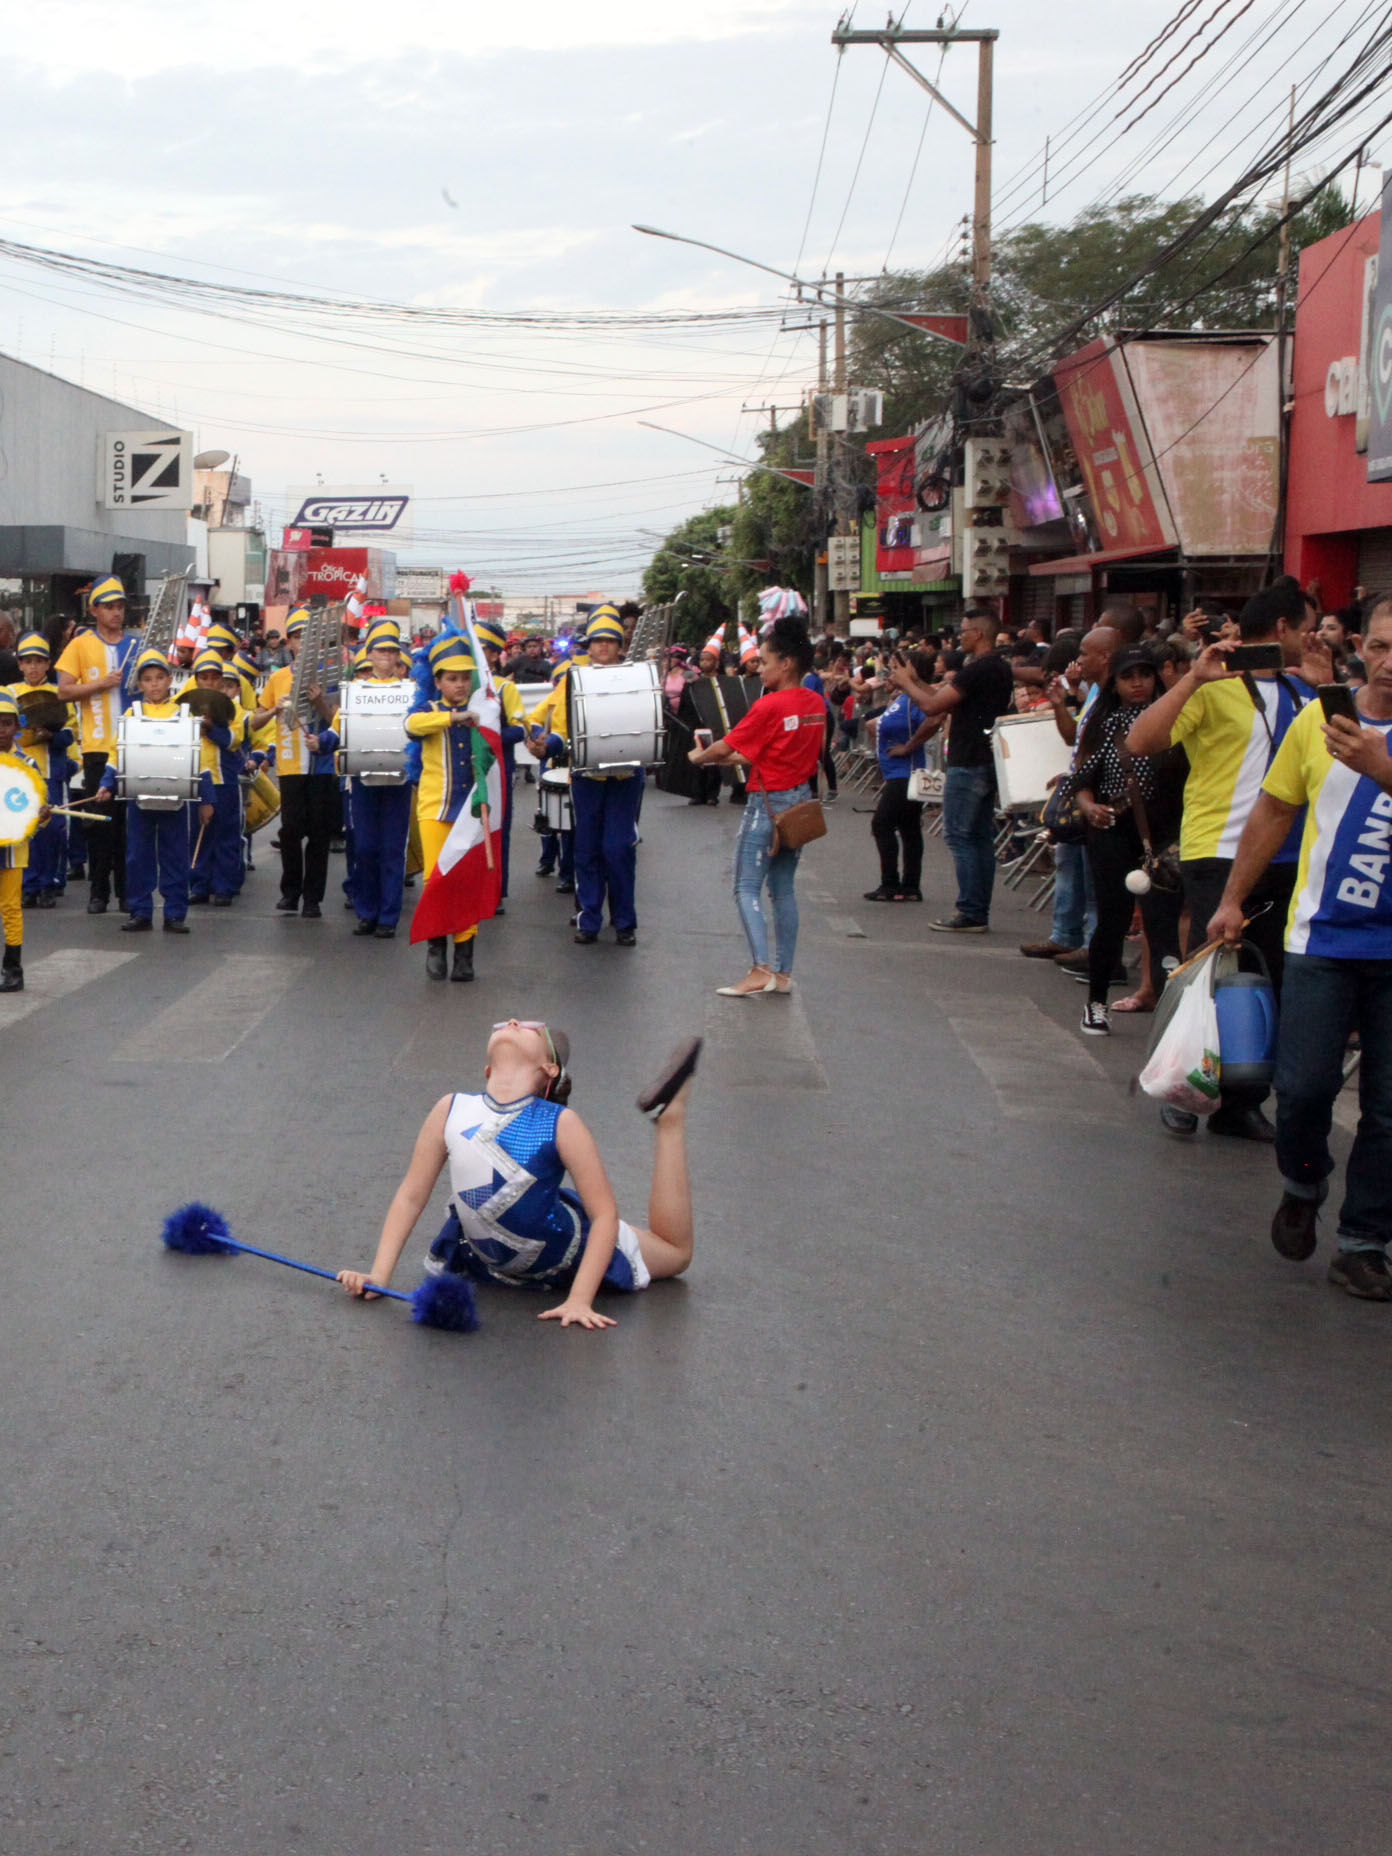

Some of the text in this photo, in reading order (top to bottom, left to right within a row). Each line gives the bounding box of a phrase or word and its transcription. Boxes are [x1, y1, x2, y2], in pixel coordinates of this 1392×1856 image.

[113, 440, 125, 503] STUDIO
[355, 695, 409, 704] STANFORD
[4, 786, 30, 812] G
